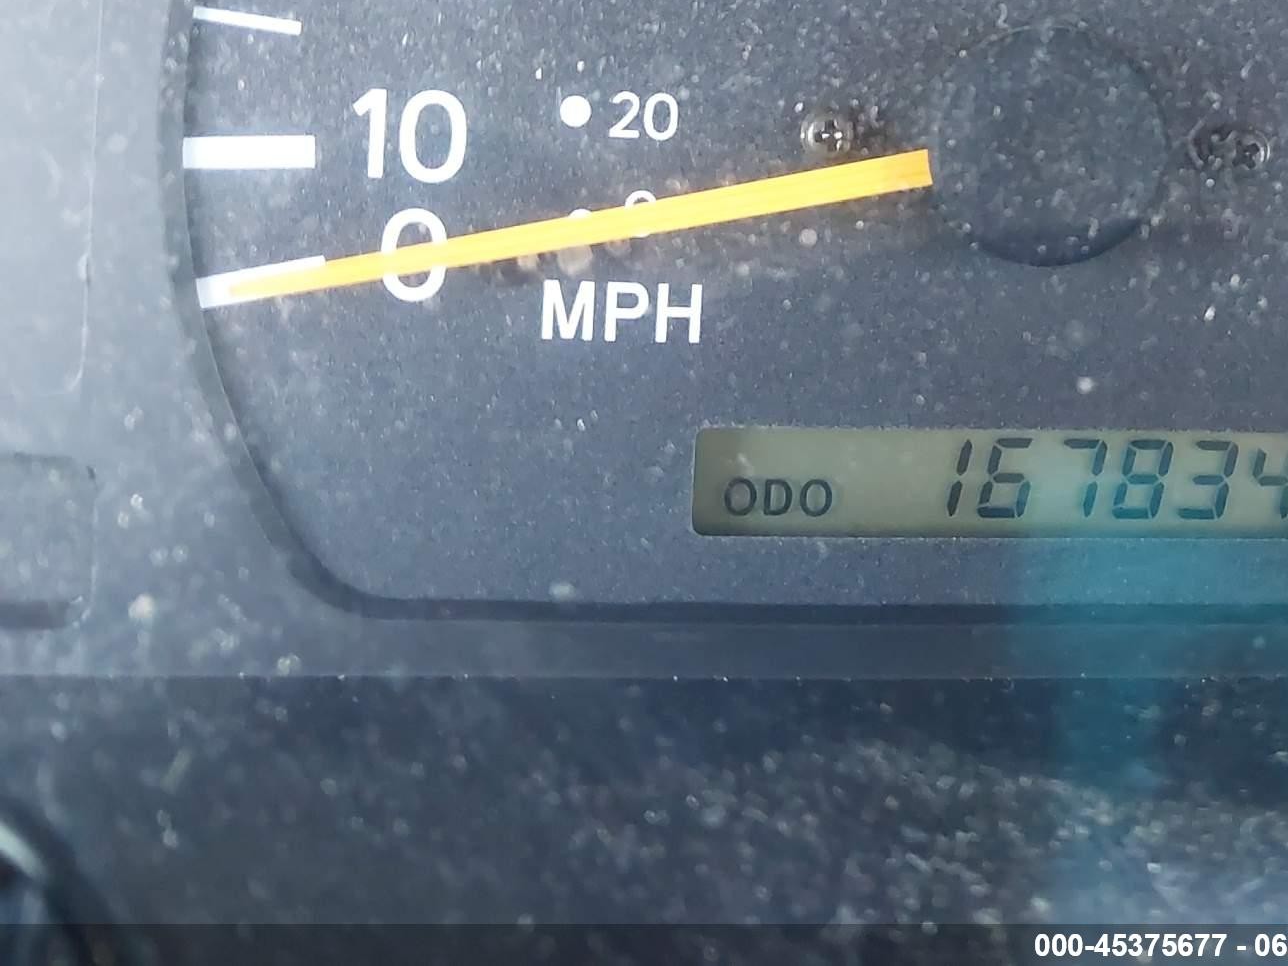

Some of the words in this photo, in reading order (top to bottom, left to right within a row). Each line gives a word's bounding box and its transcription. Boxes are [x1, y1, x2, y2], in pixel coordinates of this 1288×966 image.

[353, 89, 467, 183] 10
[609, 91, 678, 140] 20
[380, 208, 448, 301] 0
[542, 280, 702, 343] MPH
[723, 478, 833, 517] ODO
